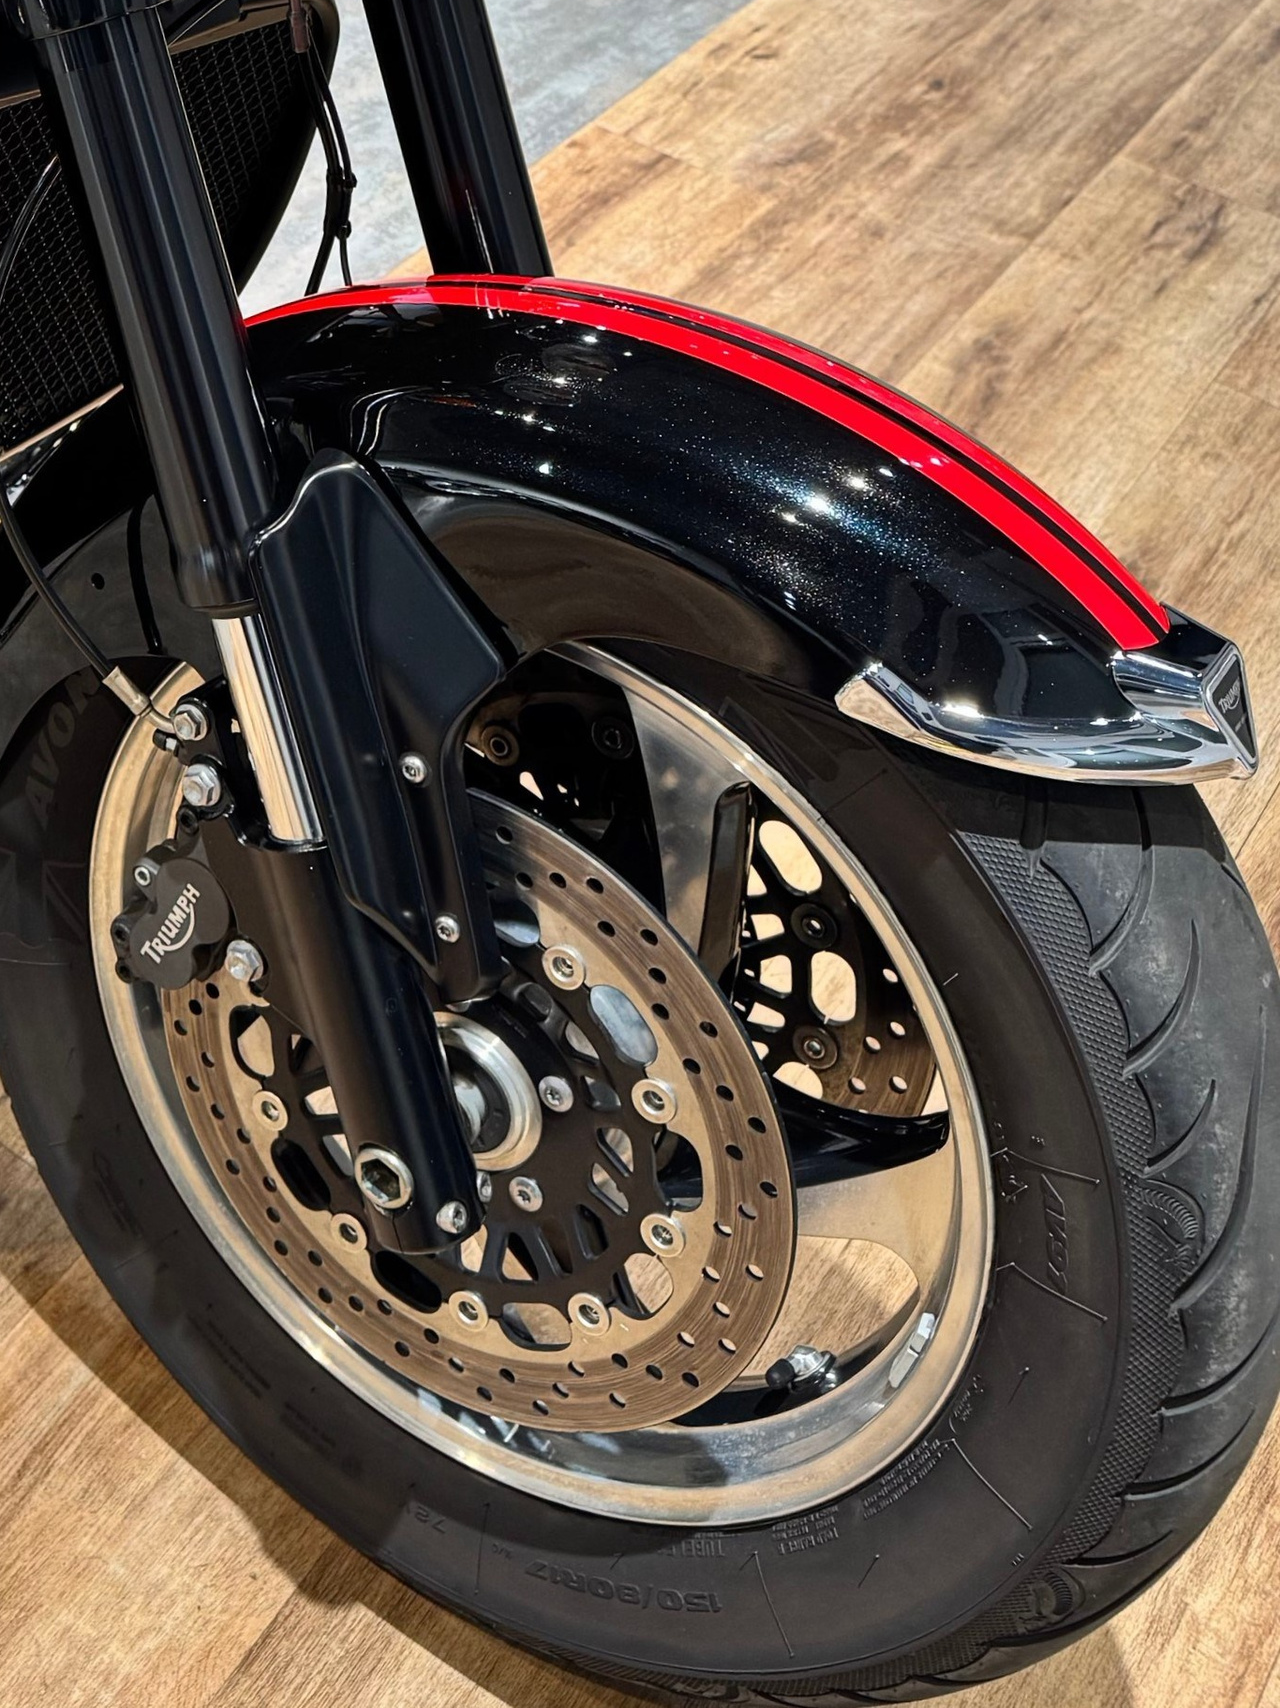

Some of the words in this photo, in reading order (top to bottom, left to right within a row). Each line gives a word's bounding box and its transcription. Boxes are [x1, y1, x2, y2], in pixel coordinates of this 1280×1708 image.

[23, 673, 105, 823] AVON
[140, 882, 200, 965] TRIUMPH
[524, 1560, 723, 1614] 150/80R17
